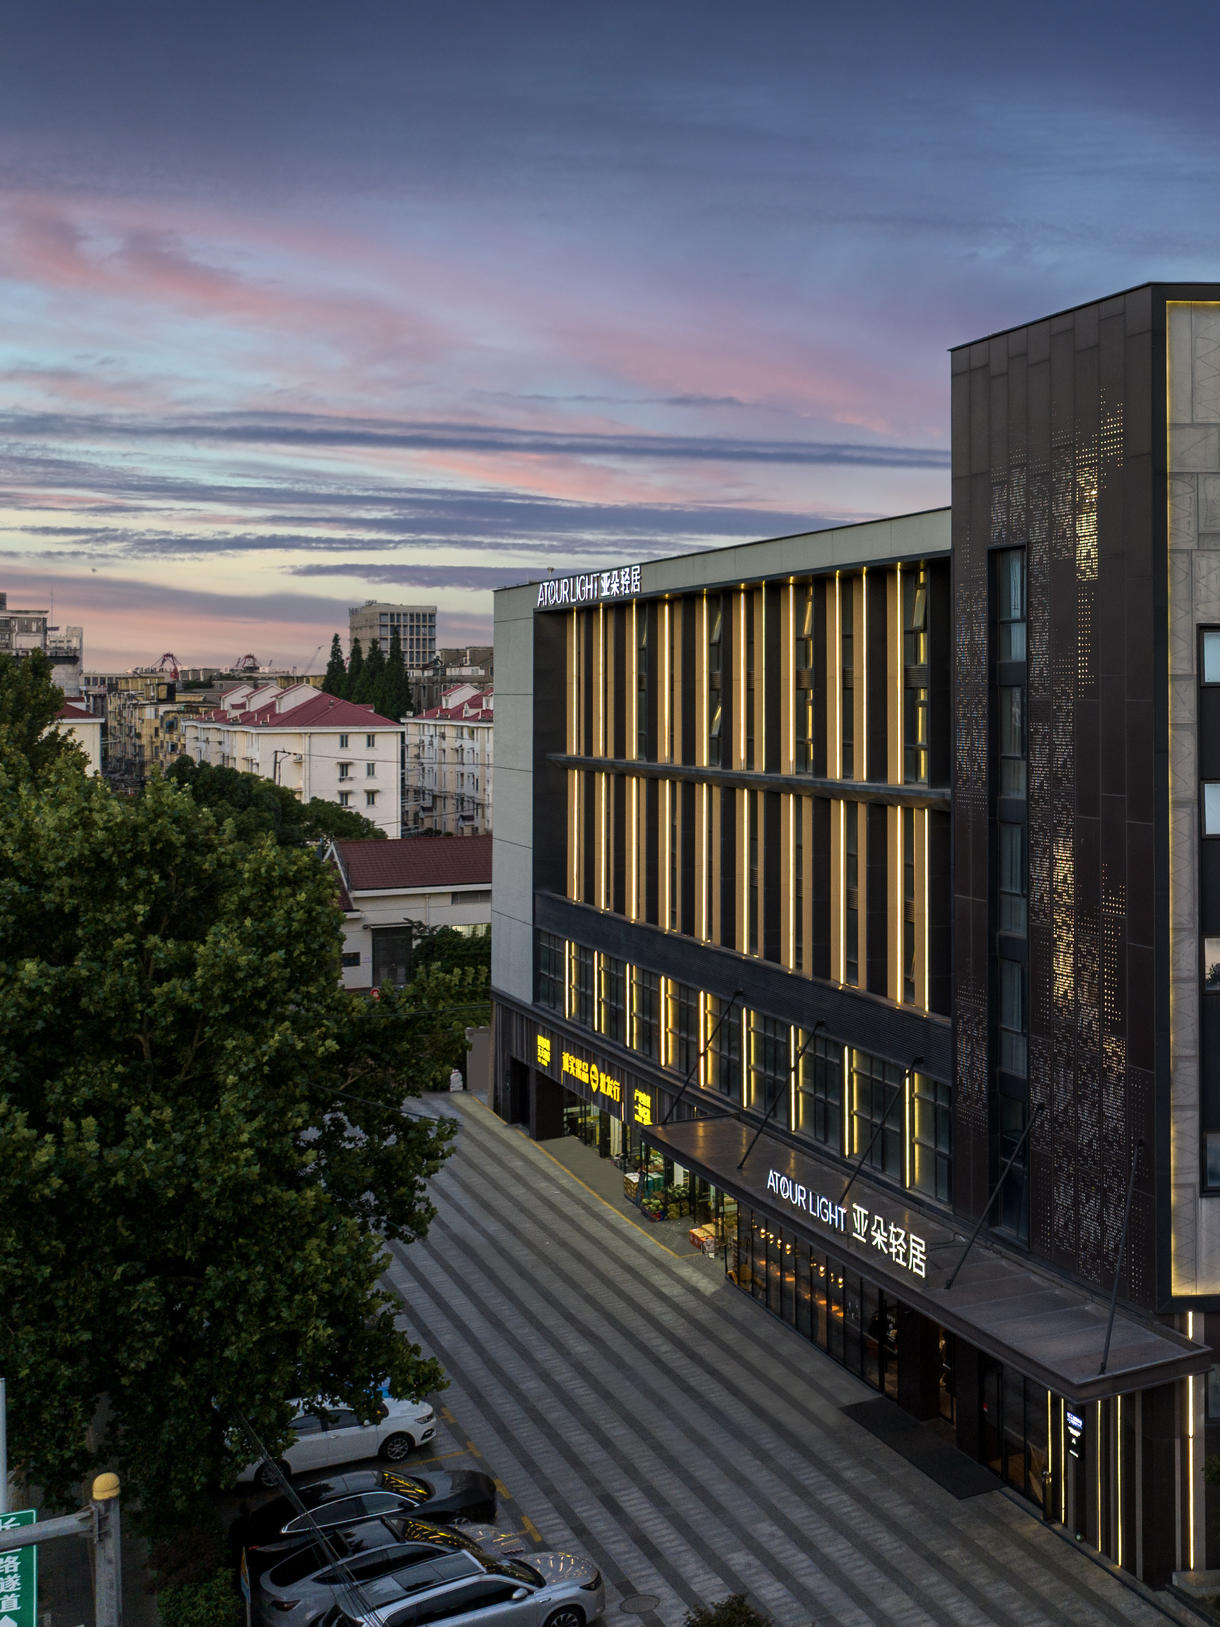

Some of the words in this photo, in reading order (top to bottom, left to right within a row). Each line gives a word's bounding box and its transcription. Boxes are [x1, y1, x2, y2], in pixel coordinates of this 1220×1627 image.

[537, 578, 569, 607] ATOUR
[570, 573, 600, 602] LIGHT
[600, 565, 641, 597] 亚朵轻居
[767, 1169, 807, 1211] ATOUR
[809, 1191, 847, 1232] LIGHT
[852, 1202, 928, 1279] 亚朵轻居
